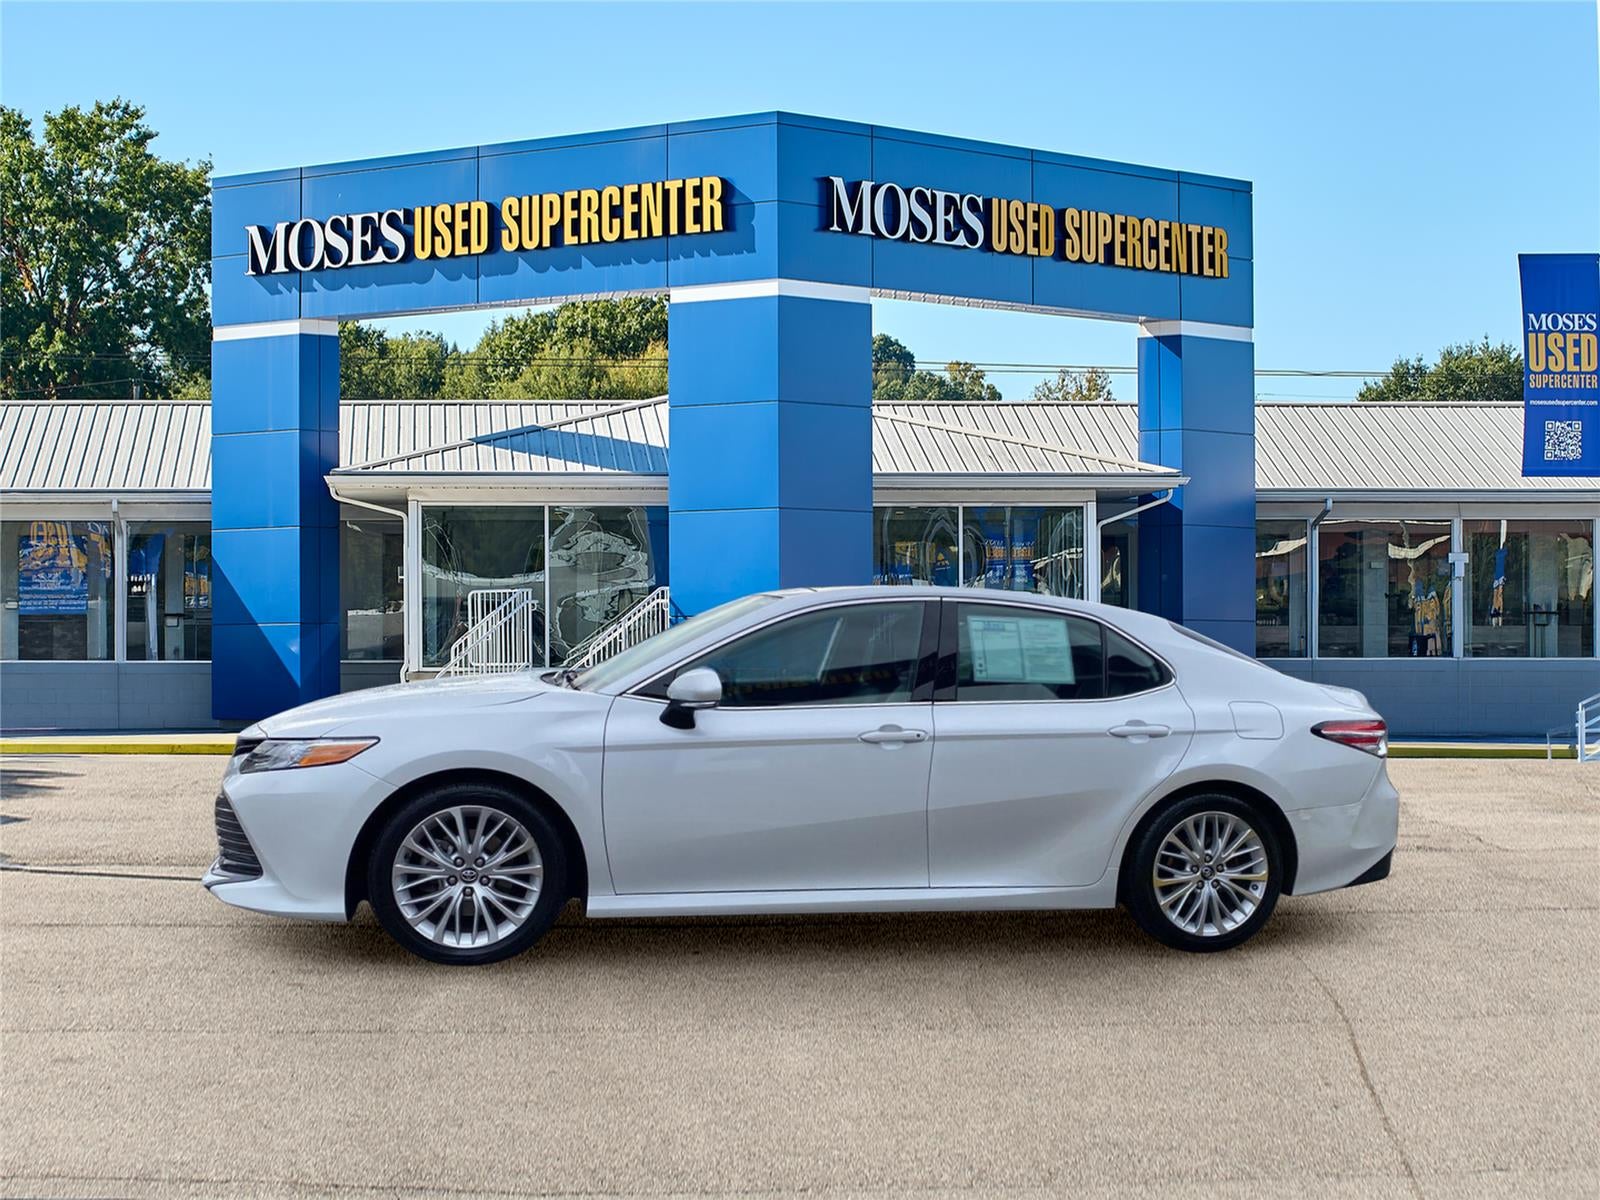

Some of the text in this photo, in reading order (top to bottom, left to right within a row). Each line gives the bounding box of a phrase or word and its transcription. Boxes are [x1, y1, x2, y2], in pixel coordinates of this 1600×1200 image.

[244, 176, 724, 277] MOSES USED SUPERCENTER
[827, 175, 1230, 279] MOSES USED SUPERCENTER
[1527, 313, 1598, 332] MOSES
[1528, 333, 1598, 373] USED
[1529, 374, 1598, 389] SUPERCENTER
